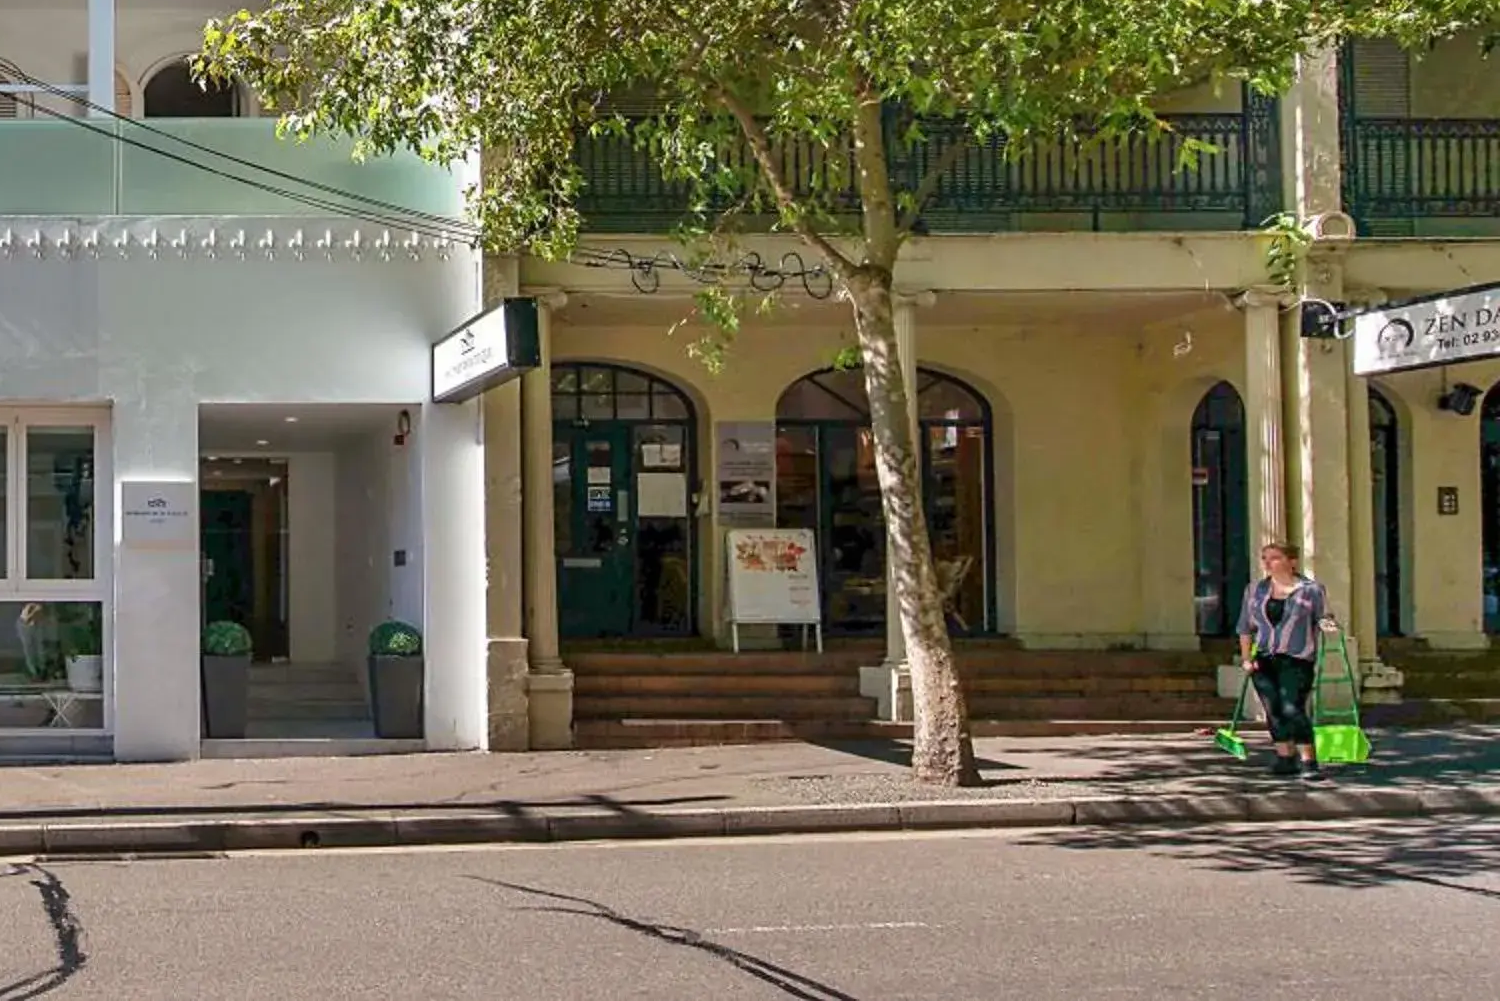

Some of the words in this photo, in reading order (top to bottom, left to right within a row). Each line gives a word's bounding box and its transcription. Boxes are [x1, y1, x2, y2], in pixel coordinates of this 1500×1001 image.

[1424, 312, 1467, 335] ZEN
[1437, 337, 1461, 349] Tel:
[1463, 332, 1479, 346] 02
